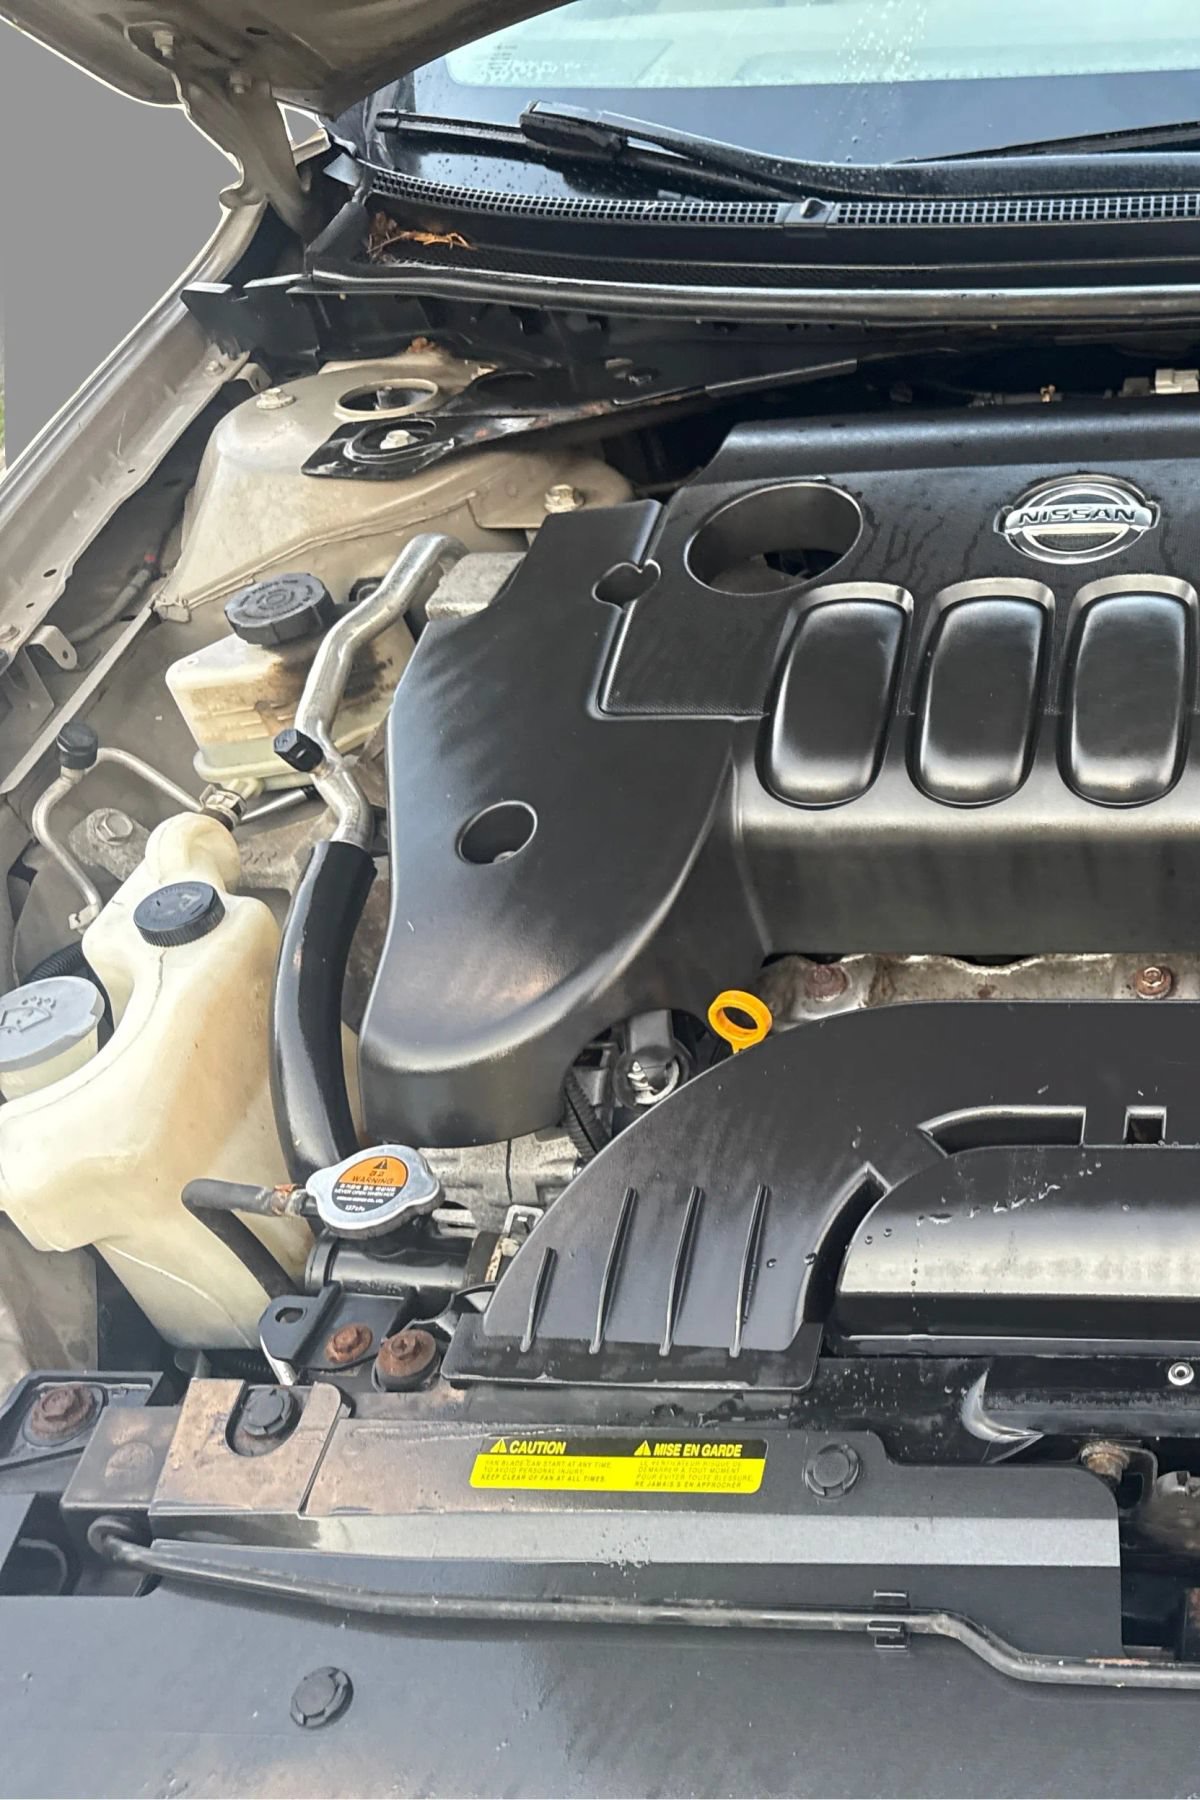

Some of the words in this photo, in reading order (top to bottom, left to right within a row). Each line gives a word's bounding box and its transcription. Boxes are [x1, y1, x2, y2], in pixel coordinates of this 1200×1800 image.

[1018, 508, 1136, 525] NISSAN
[352, 1176, 394, 1184] WARNING
[509, 1441, 567, 1454] CAUTION
[653, 1443, 682, 1456] MISE
[682, 1443, 700, 1457] EN
[701, 1444, 743, 1457] GARDE
